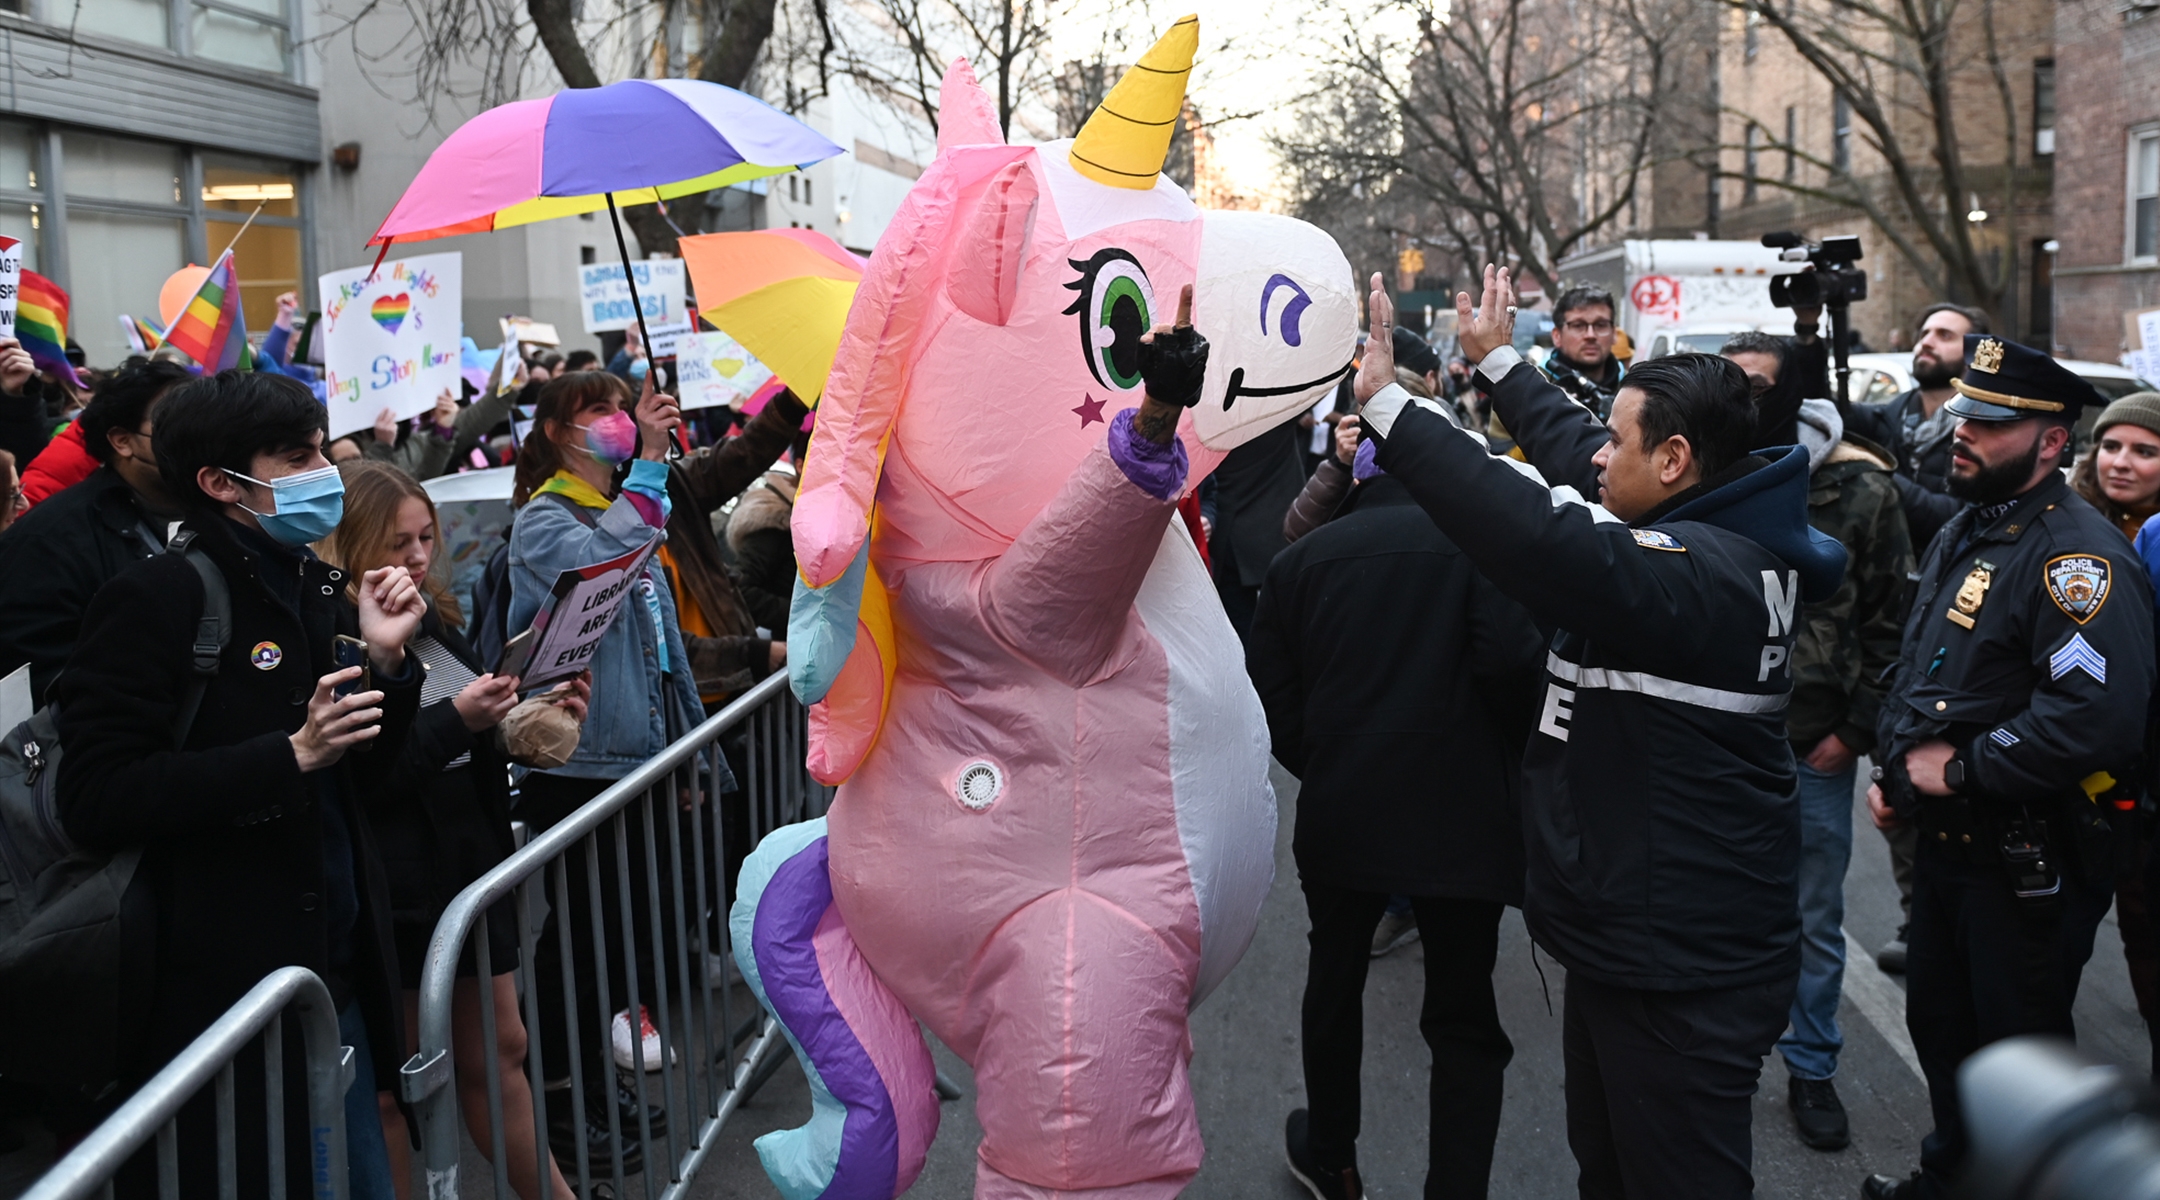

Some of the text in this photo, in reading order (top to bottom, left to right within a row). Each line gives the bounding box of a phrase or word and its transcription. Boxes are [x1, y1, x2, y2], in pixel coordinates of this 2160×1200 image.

[326, 262, 441, 333] Jackson Heights
[328, 343, 455, 403] Drag Story Hour
[2050, 565, 2105, 577] DEPARTMENT
[2060, 558, 2093, 567] POLICE
[2051, 585, 2074, 612] CITY OF
[2084, 579, 2107, 615] NEW YORK
[577, 608, 611, 638] ARE
